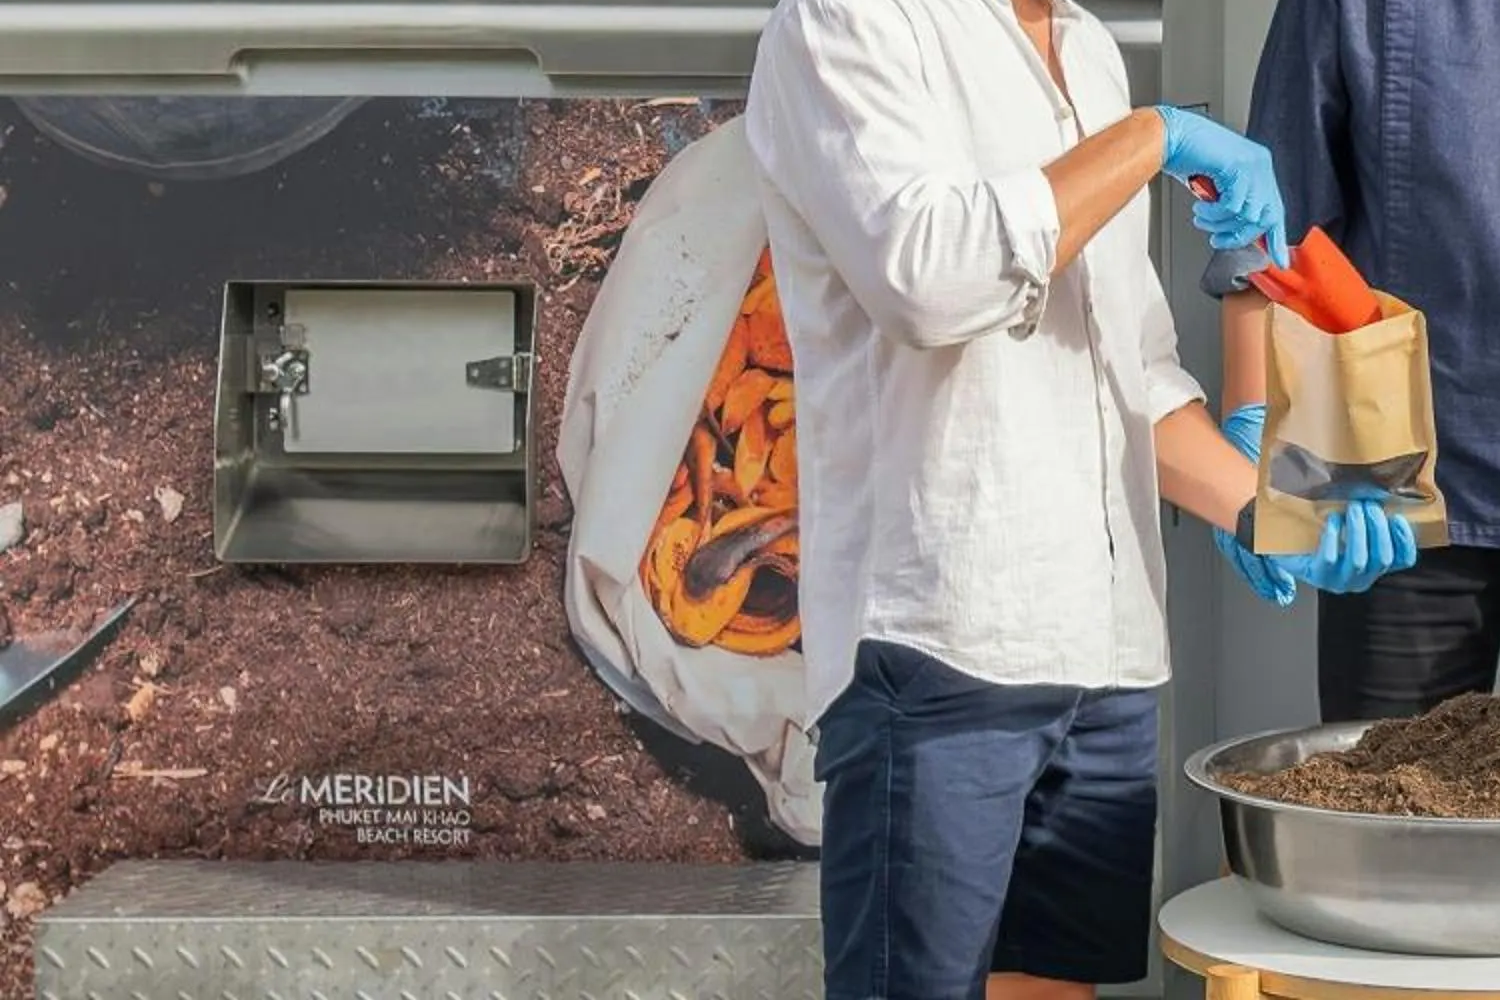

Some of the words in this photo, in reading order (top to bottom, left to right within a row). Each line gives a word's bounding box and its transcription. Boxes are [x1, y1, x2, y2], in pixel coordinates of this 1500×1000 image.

[301, 775, 470, 805] MERIDIEN
[319, 809, 381, 825] PHUKET
[385, 809, 417, 825] MAI
[423, 810, 470, 826] KHAO
[357, 828, 408, 844] BEACH
[413, 828, 470, 845] RESORT
